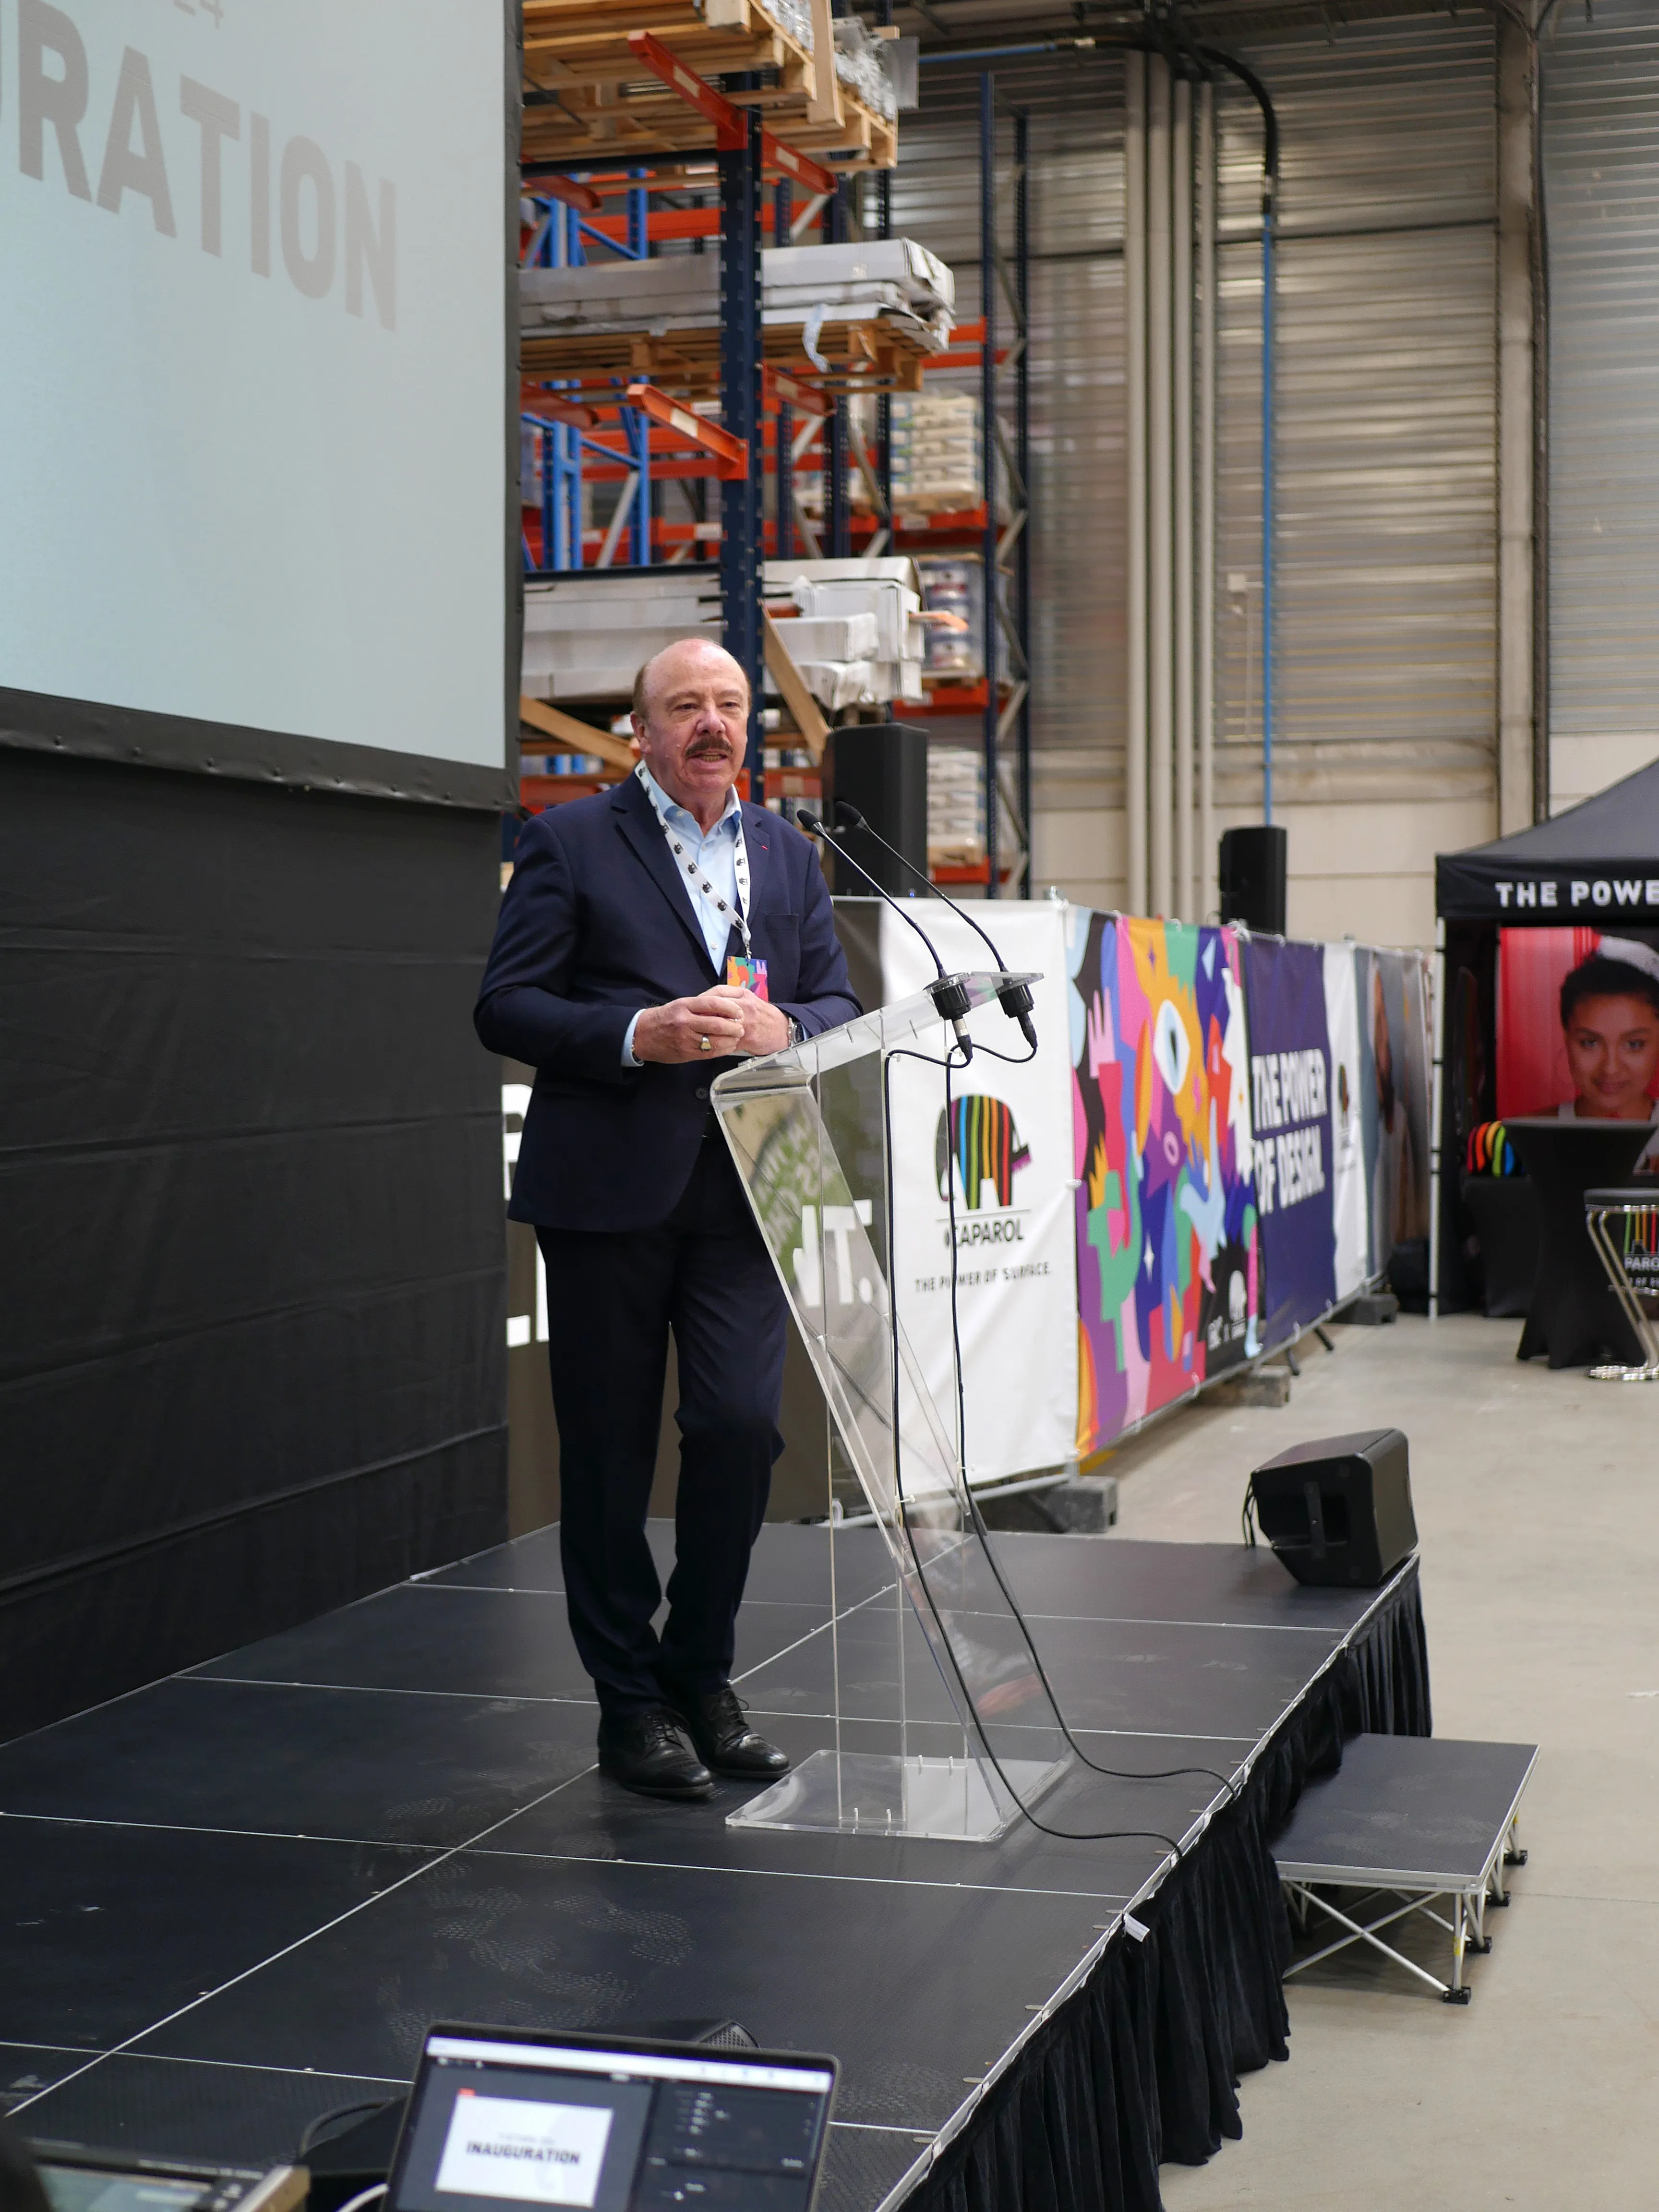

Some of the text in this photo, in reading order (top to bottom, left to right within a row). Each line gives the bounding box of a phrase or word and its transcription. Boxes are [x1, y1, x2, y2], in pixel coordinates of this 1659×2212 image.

[0, 0, 397, 332] RATION
[1494, 879, 1659, 908] THE POWE
[1251, 1048, 1328, 1132] THE POWER
[1254, 1137, 1276, 1217] OF
[914, 1275, 936, 1293] THE
[985, 1268, 998, 1283] OF
[465, 2140, 581, 2166] INAUGURATION
